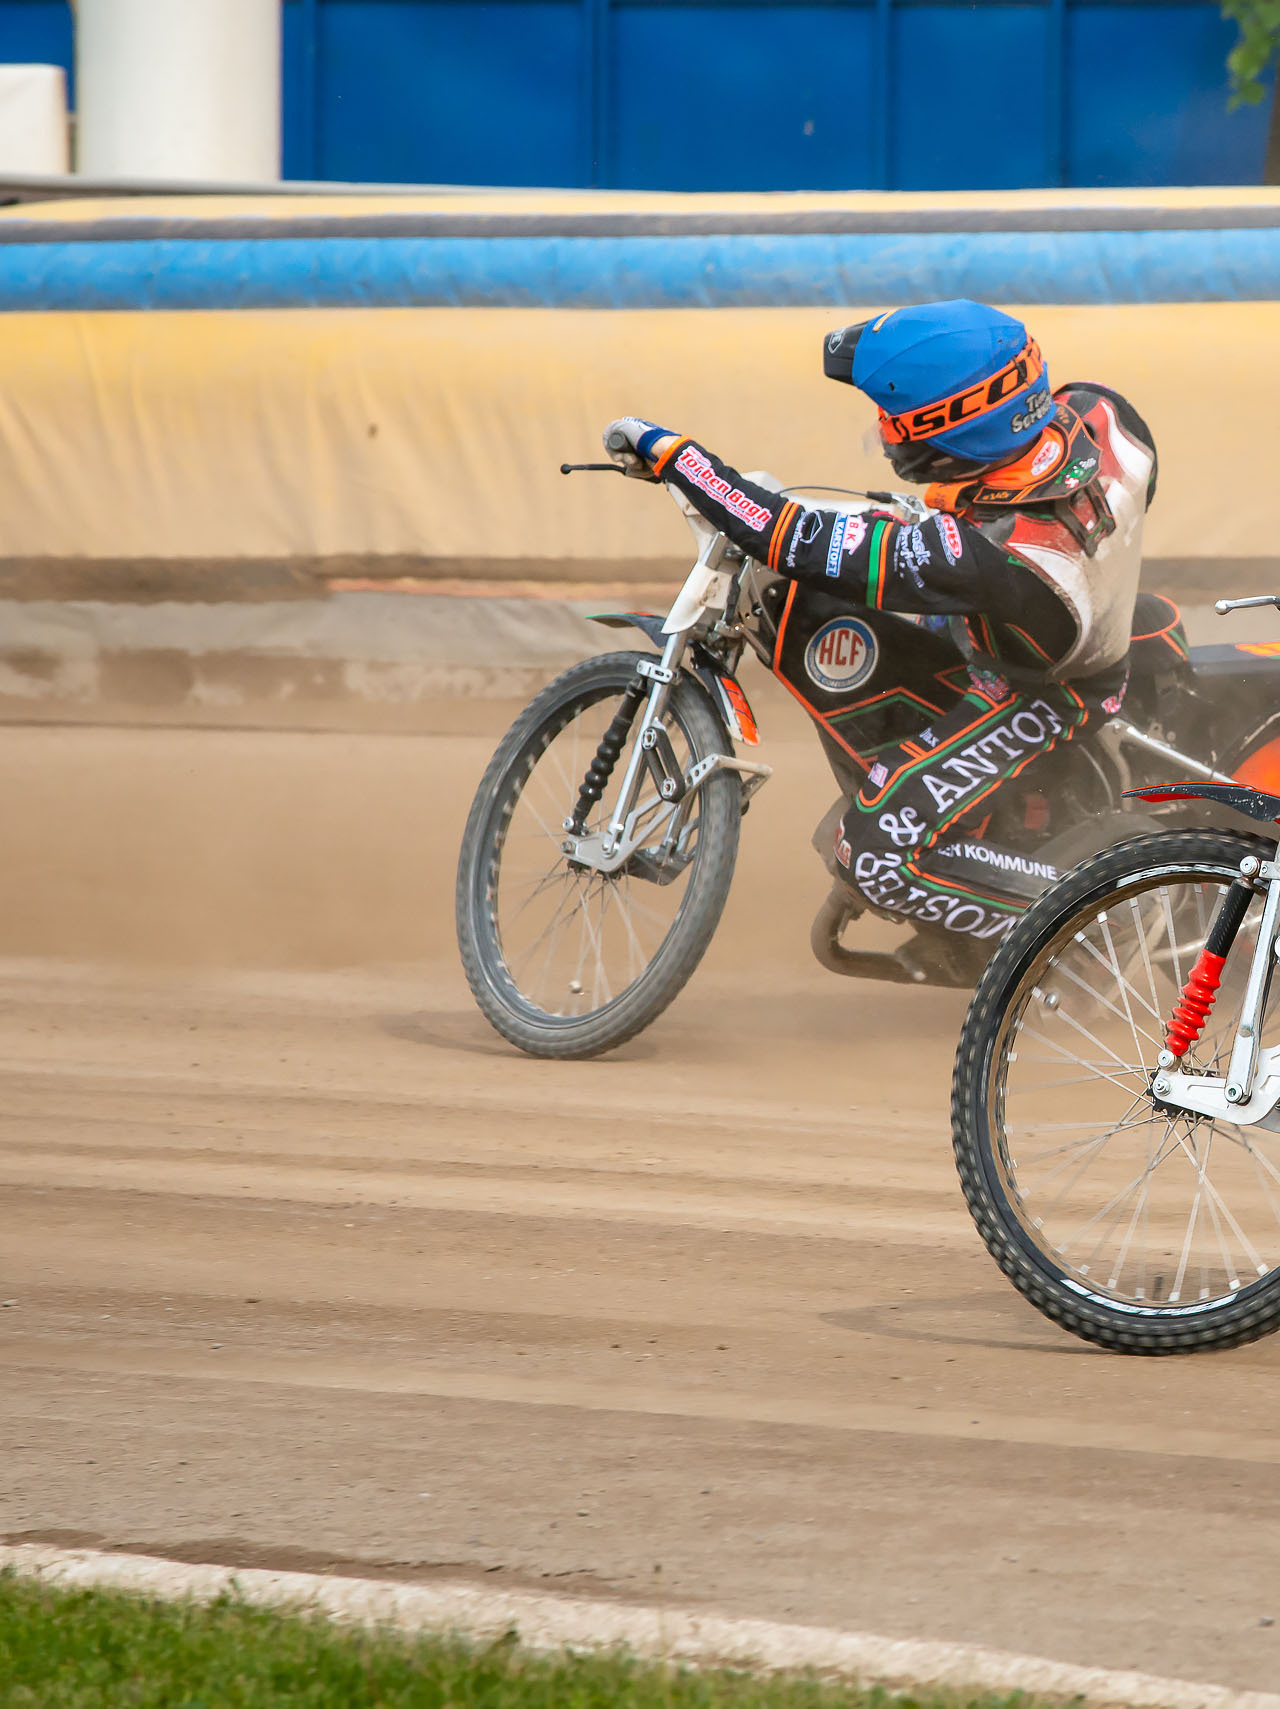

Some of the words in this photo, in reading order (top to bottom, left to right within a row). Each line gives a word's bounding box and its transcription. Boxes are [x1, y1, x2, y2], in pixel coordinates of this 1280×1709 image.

[912, 360, 1028, 436] SCO
[680, 451, 730, 494] Torben
[818, 629, 863, 666] HCF
[879, 806, 927, 847] &
[964, 844, 1058, 881] KOMMUNE
